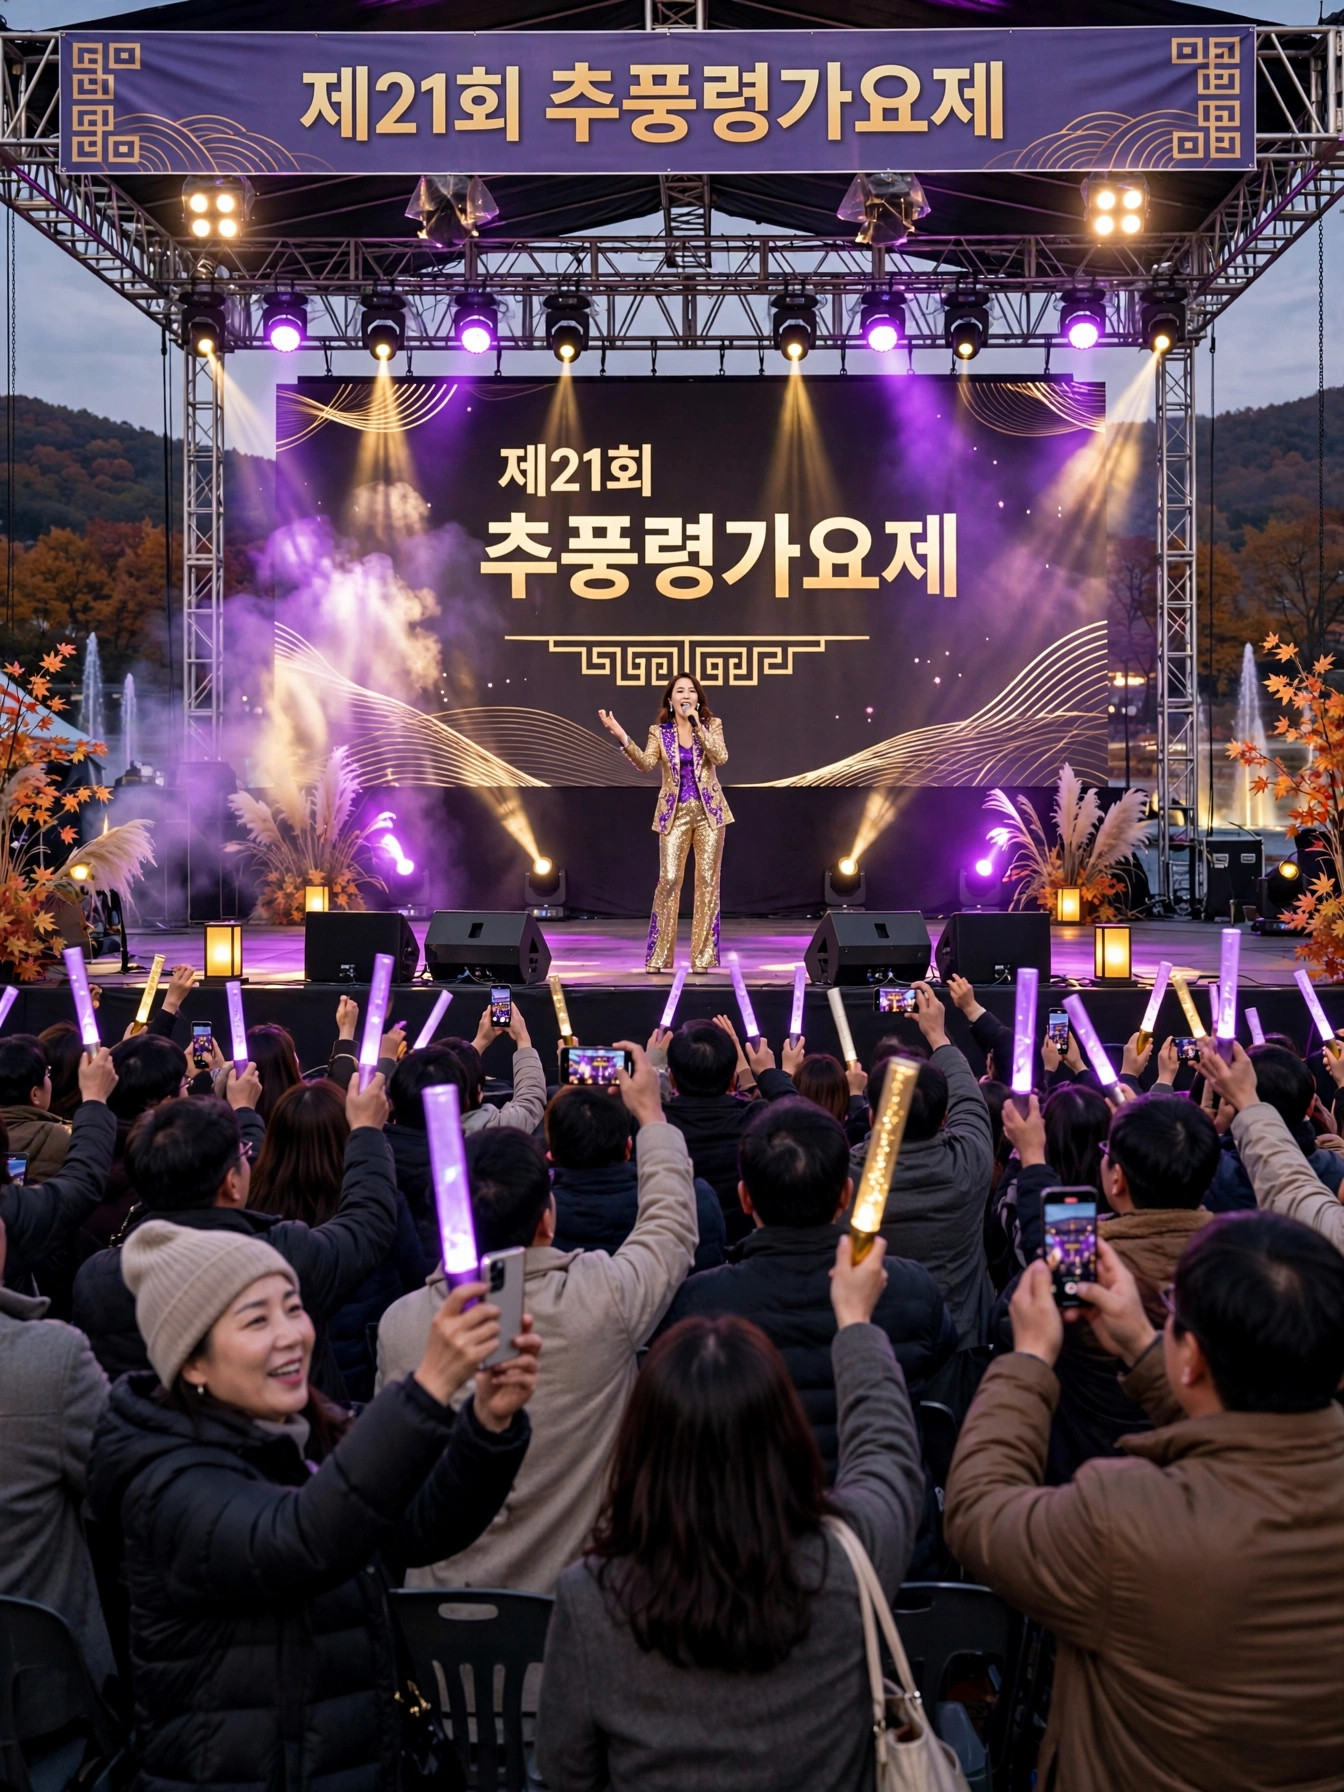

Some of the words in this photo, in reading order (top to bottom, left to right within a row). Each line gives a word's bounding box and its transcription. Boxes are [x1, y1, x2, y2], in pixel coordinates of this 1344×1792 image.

[300, 65, 520, 142] 제21회
[545, 61, 1004, 144] 추풍령가요제
[498, 443, 652, 497] 제21회
[480, 512, 957, 600] 추풍령가요제
